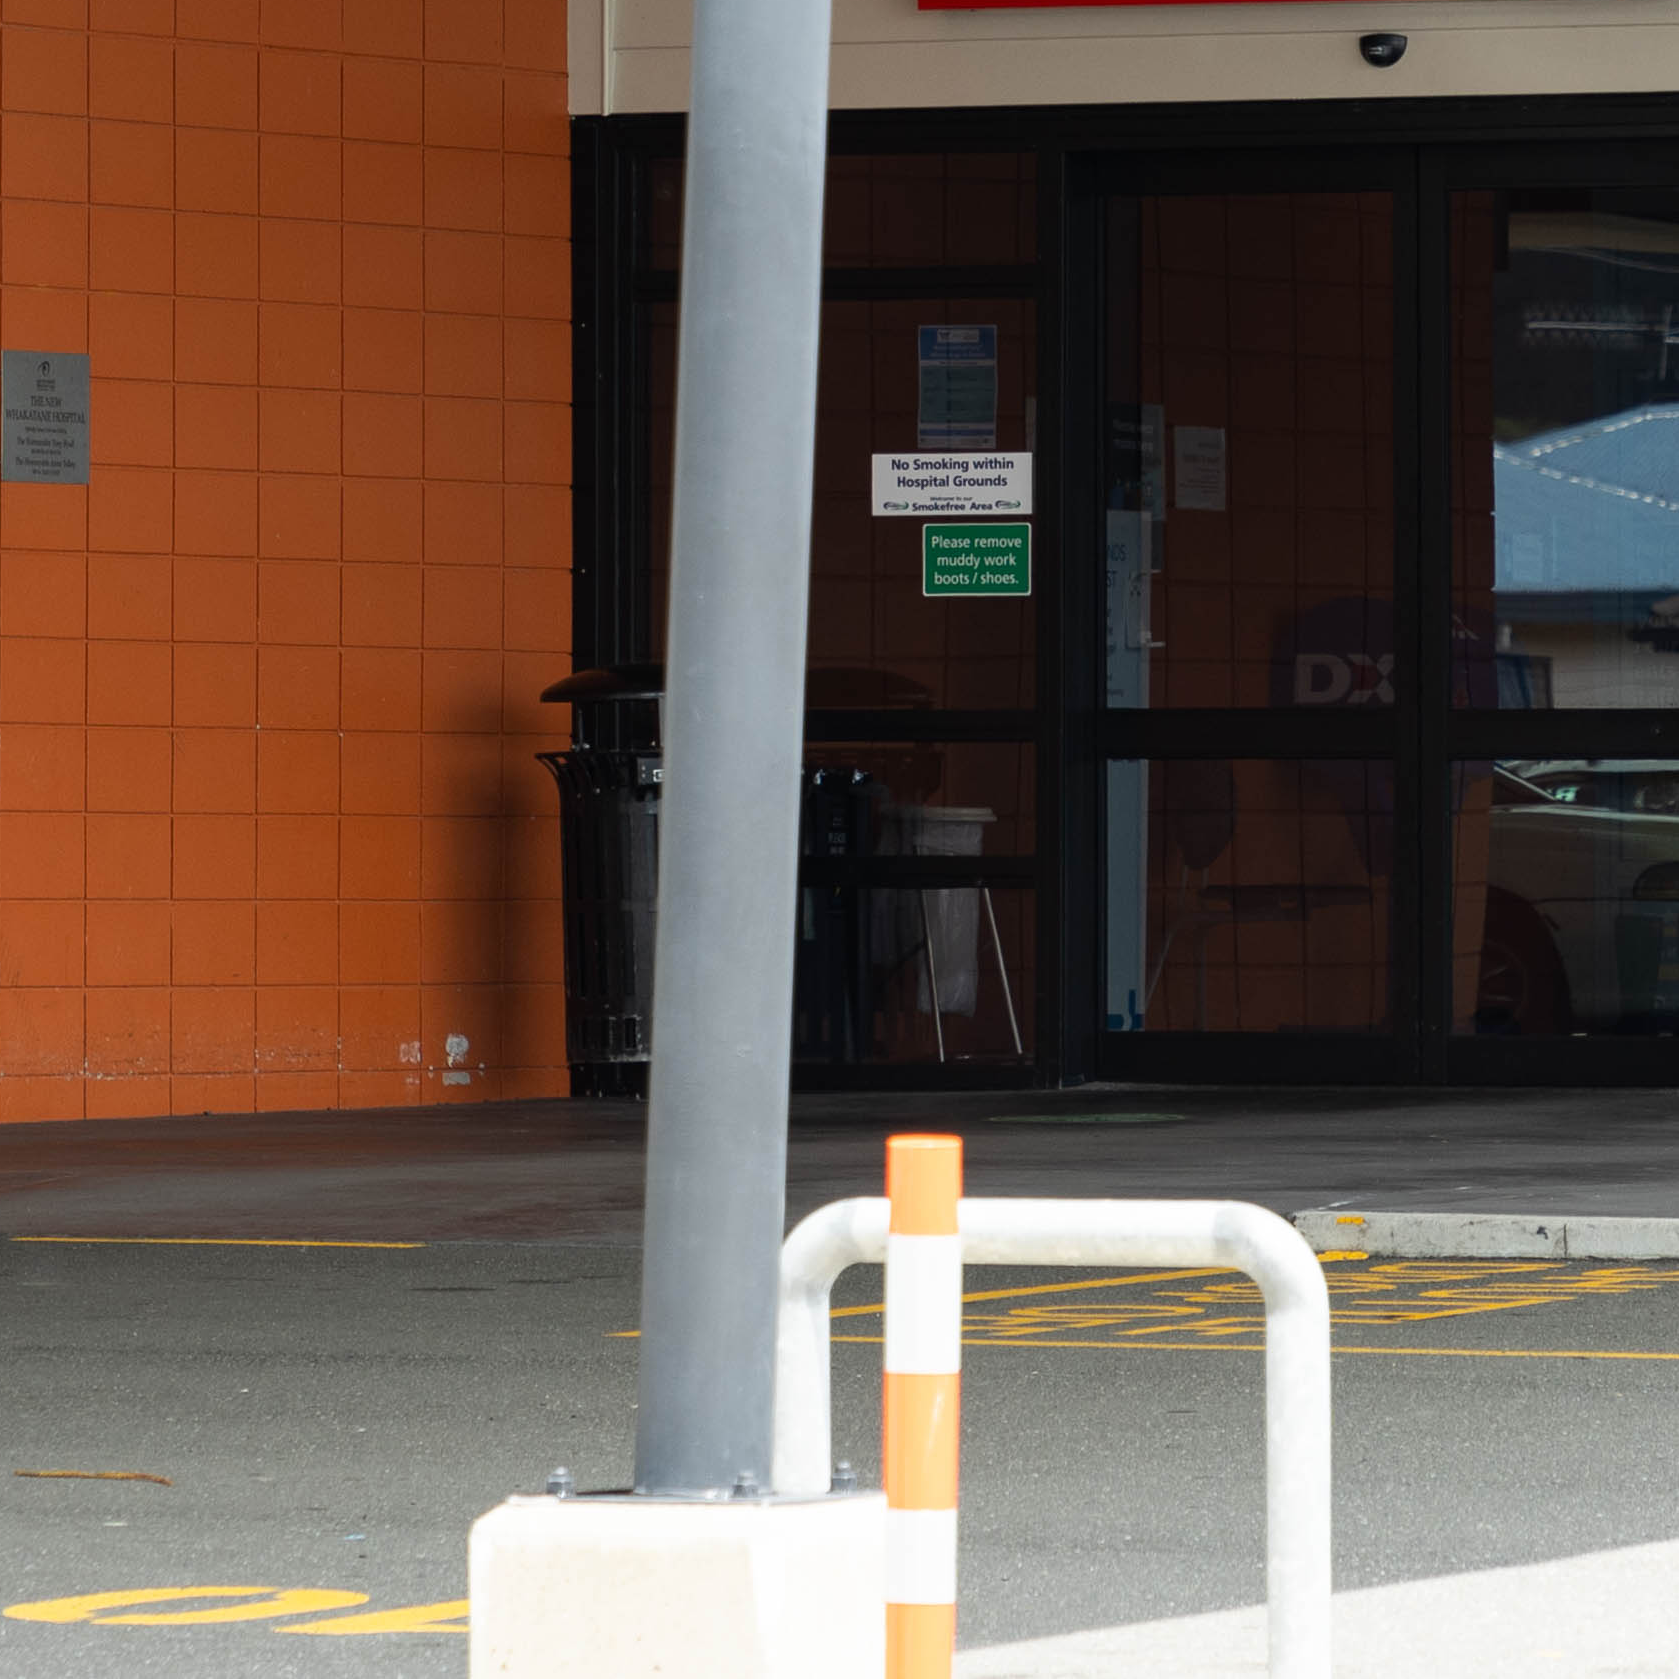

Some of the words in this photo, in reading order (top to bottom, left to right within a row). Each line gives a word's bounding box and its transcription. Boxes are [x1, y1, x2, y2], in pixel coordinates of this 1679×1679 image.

[892, 460, 909, 470] No
[914, 458, 969, 472] Smoking
[973, 457, 1013, 469] within
[898, 475, 949, 490] Hospital
[953, 475, 1007, 486] Grounds
[912, 502, 965, 512] Smokefree
[970, 501, 992, 511] Area
[932, 536, 970, 548] Please
[975, 538, 1021, 547] remove
[937, 554, 980, 569] muddy
[984, 553, 1016, 565] work
[935, 572, 969, 584] boots
[973, 572, 977, 584] /
[981, 572, 1018, 584] shoes.
